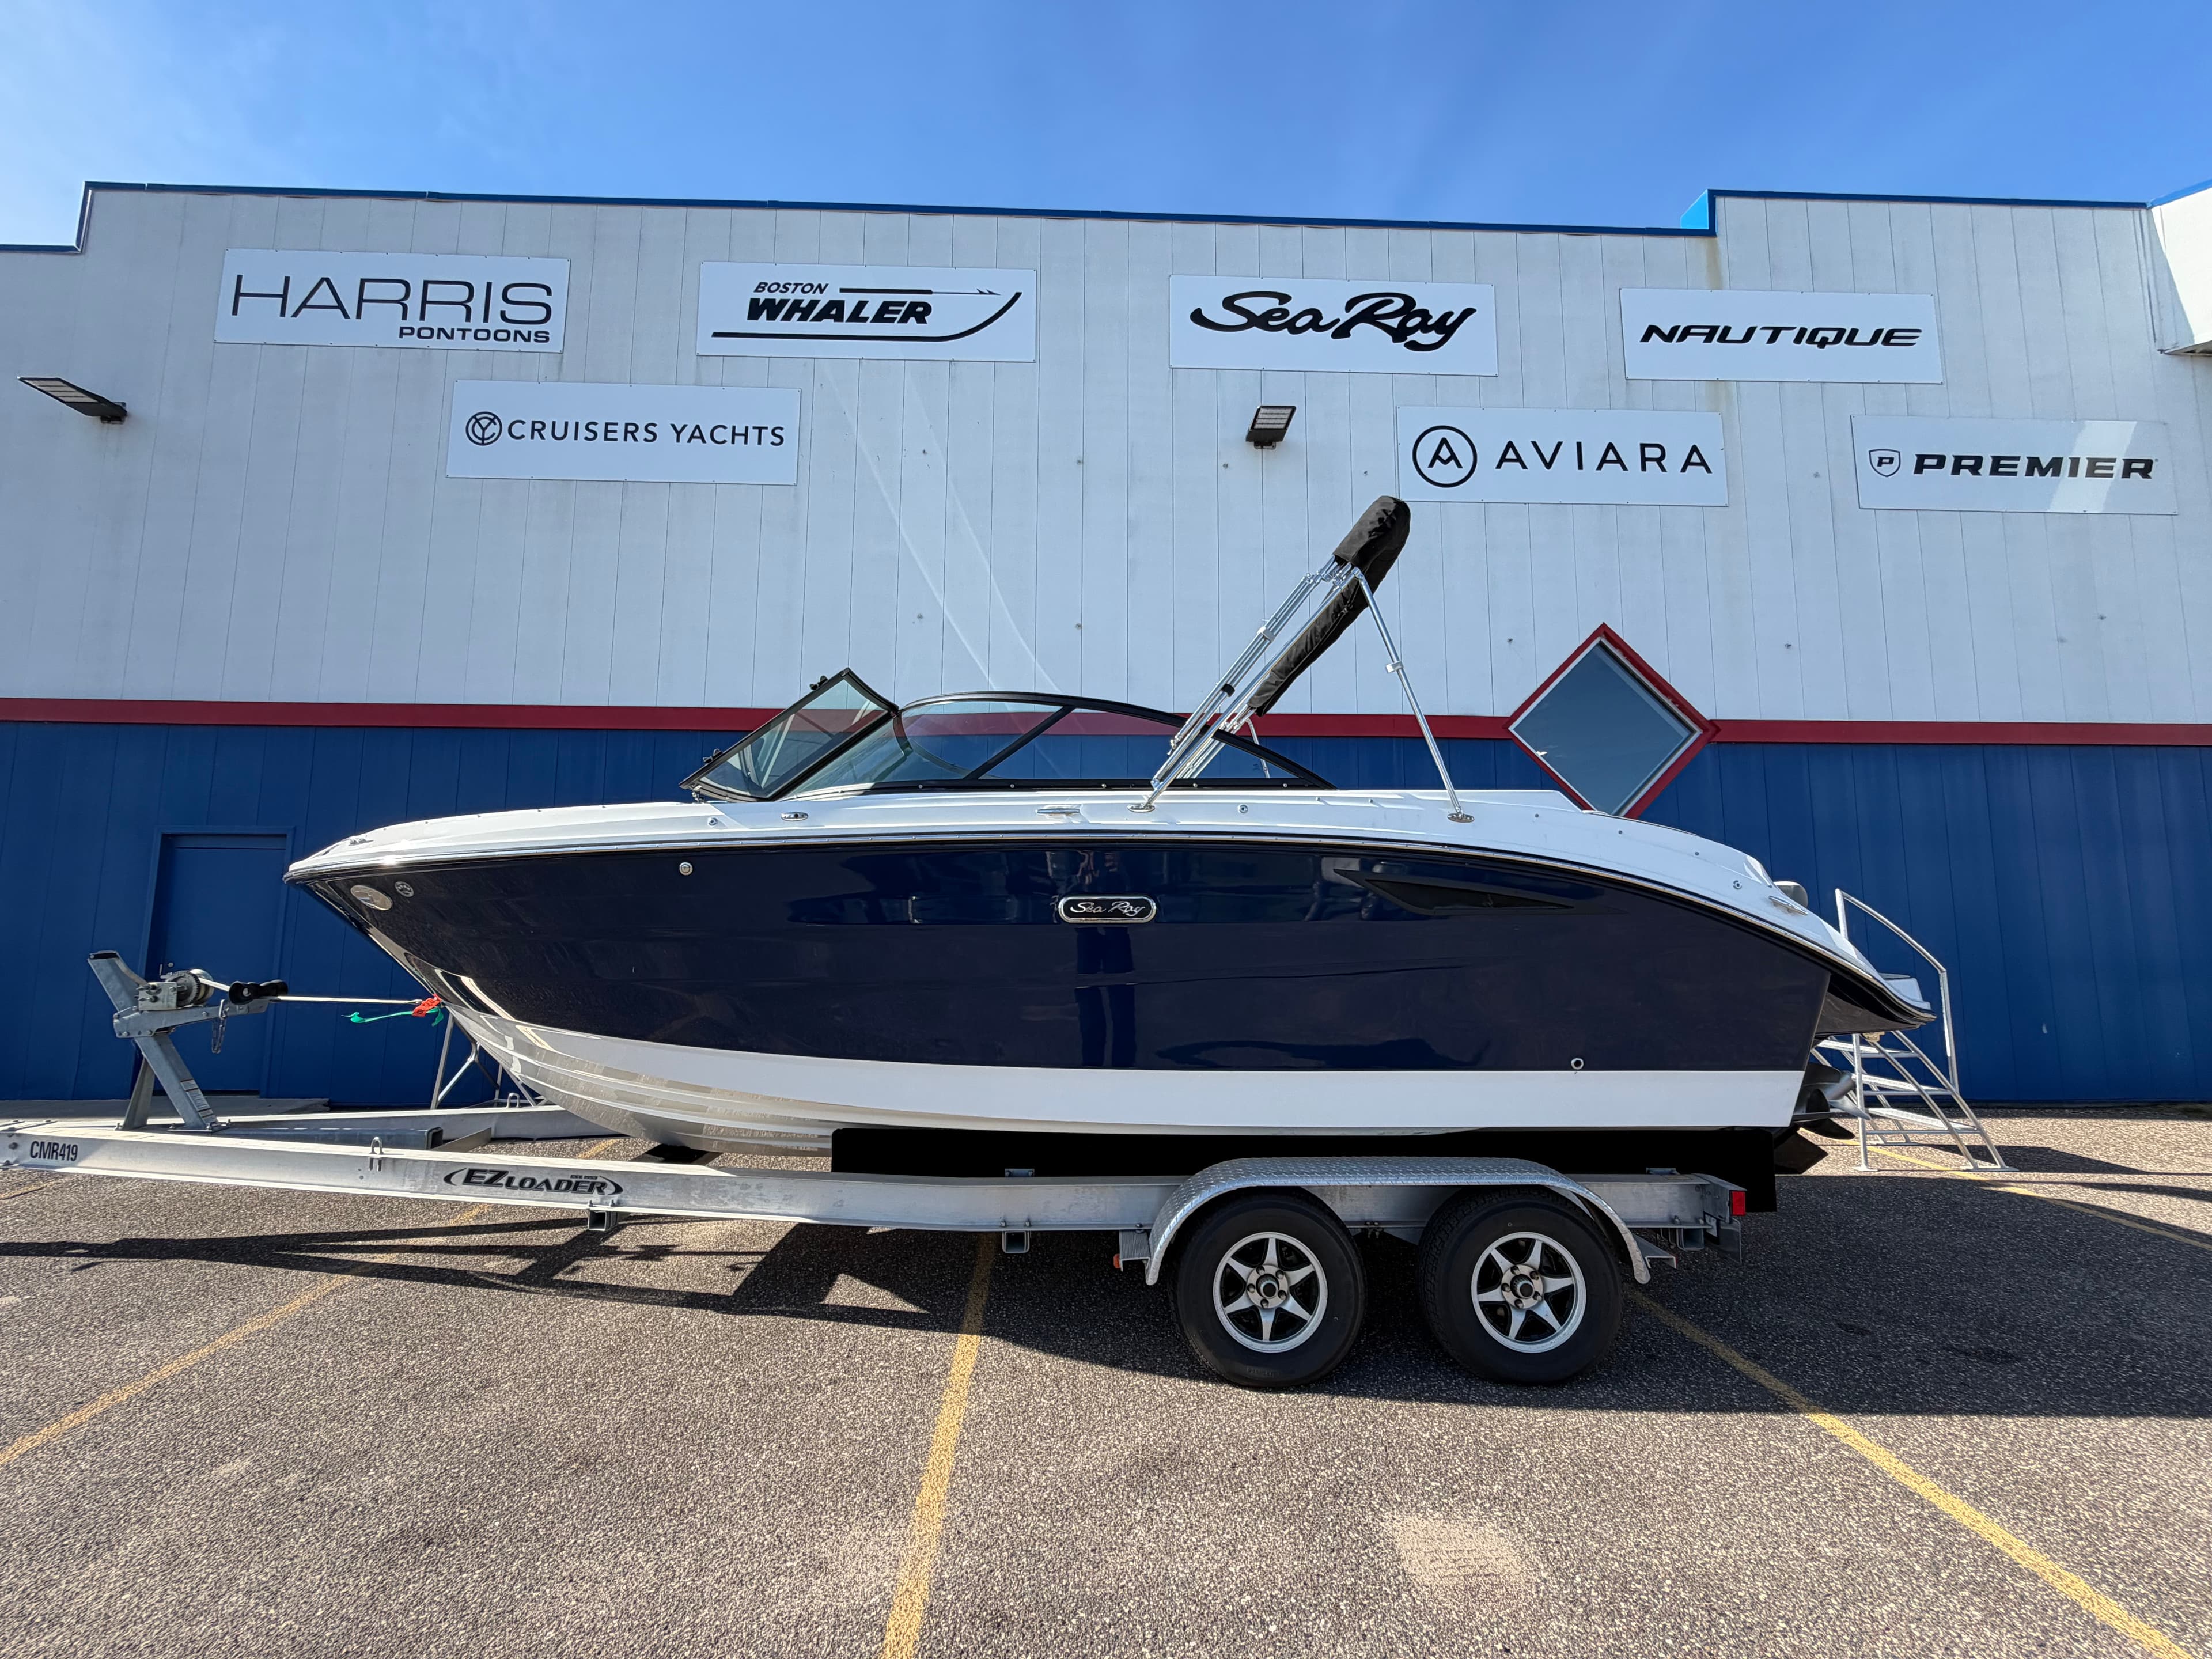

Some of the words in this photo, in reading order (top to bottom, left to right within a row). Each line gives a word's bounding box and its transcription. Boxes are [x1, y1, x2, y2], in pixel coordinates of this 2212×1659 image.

[232, 274, 552, 325] HARRIS
[753, 282, 829, 294] BOSTON
[747, 297, 932, 324] WHALER
[1190, 291, 1340, 335] Sea
[1331, 292, 1477, 352] Ray
[399, 326, 550, 343] PONTOONS
[1639, 324, 1922, 349] NAUTIQUE
[507, 419, 658, 443] CRUISERS
[670, 423, 785, 446] YACHTS
[1495, 440, 1713, 474] AVIARA
[1913, 453, 2154, 479] PREMIER
[1070, 902, 1107, 913] Sea
[1108, 901, 1146, 917] Ray
[29, 1141, 78, 1162] CMR419
